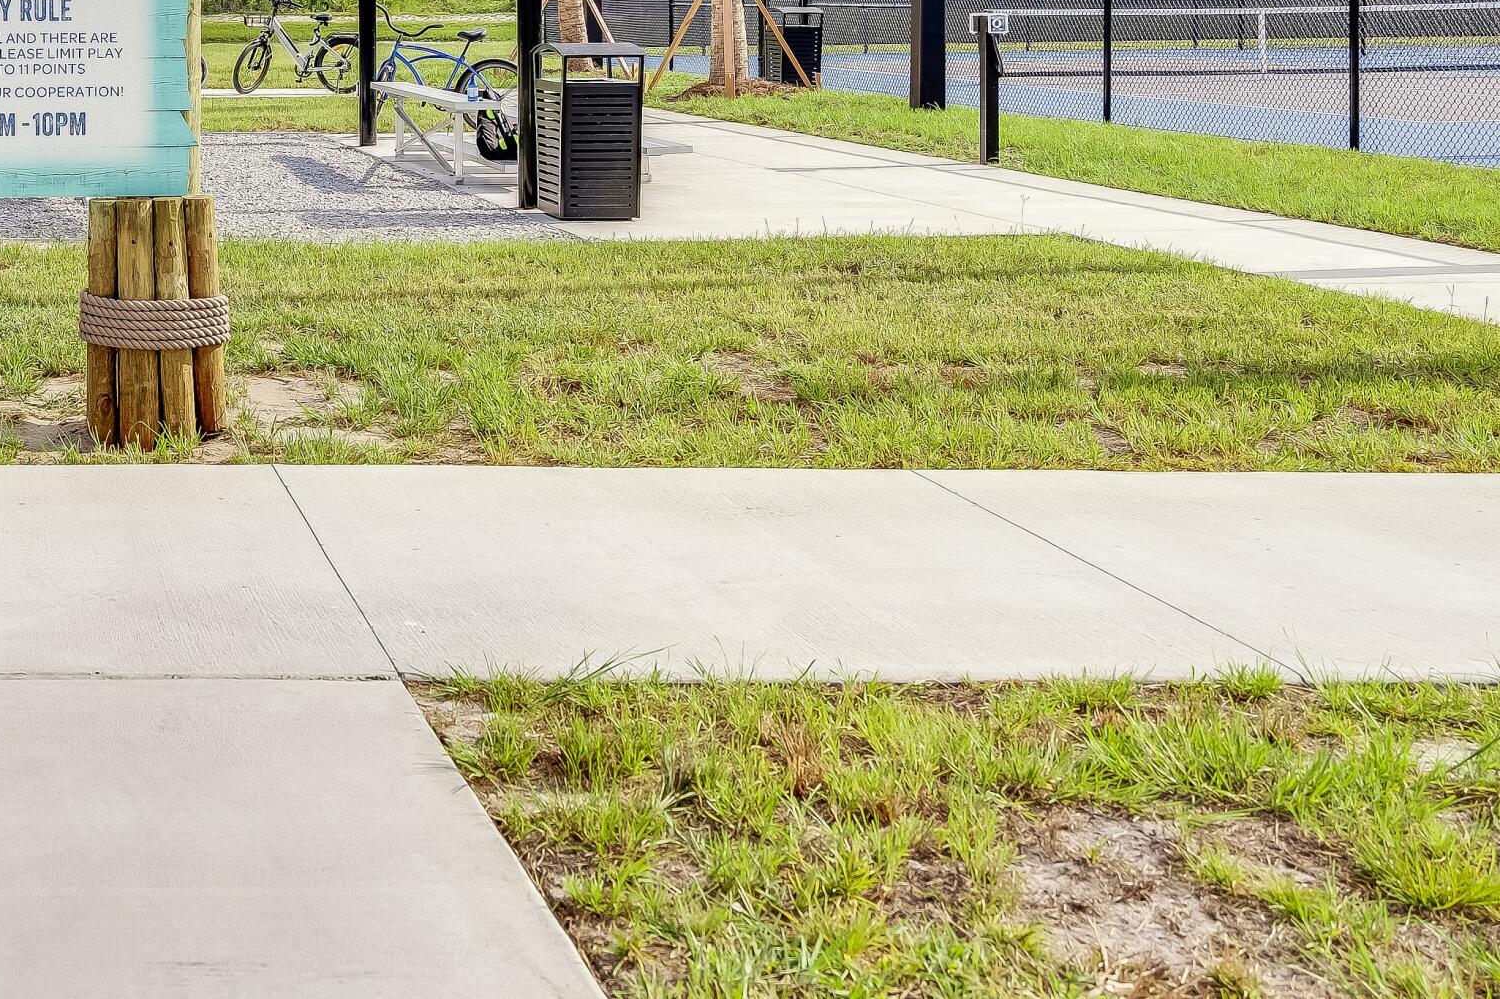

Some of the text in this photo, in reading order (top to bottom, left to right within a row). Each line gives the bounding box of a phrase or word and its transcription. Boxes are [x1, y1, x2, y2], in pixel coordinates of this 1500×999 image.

[5, 32, 37, 45] AND
[39, 32, 88, 44] THERE
[89, 31, 118, 44] ARE
[47, 47, 85, 60] LIMIT
[87, 47, 124, 59] PLAY
[18, 63, 29, 76] 11
[32, 62, 86, 76] POINTS
[14, 85, 124, 99] COOPERATION!
